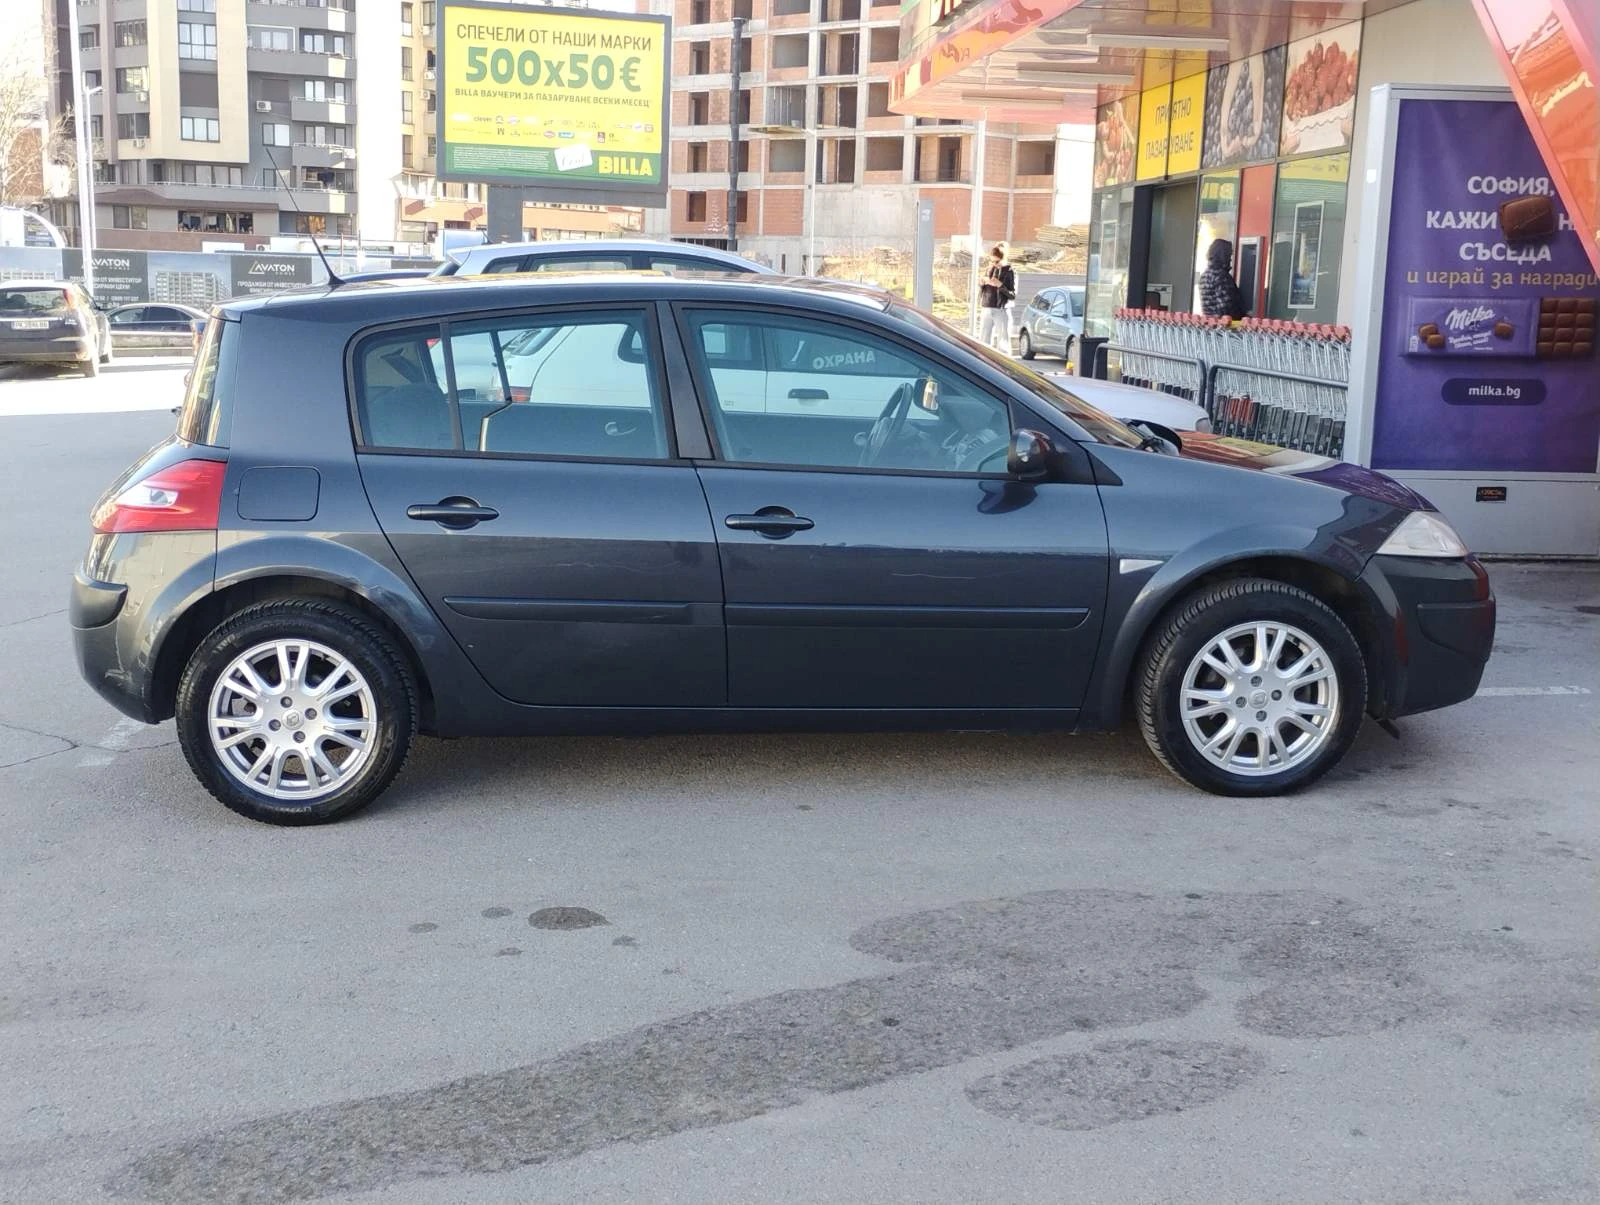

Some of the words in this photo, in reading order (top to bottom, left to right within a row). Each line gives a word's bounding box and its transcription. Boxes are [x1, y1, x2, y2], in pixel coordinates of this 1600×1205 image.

[457, 24, 524, 43] СПЕЧЕЛИ
[529, 29, 548, 44] ОТ
[552, 31, 596, 47] НАШИ
[600, 35, 651, 52] МАРКИ
[455, 88, 478, 97] BILLA
[481, 90, 522, 100] ВАУЧЕРИ
[523, 92, 534, 100] ЗА
[536, 93, 591, 104] ПАЗАРУВАНЕ
[593, 96, 621, 105] ВСЕКИ
[1155, 98, 1191, 124] ПРИЯТНО
[1146, 132, 1193, 159] ПАЗАРУВАНЕ
[598, 156, 653, 177] BILLA
[1467, 176, 1555, 196] СОФИЯ,
[1426, 211, 1497, 230] КАЖИ
[1558, 213, 1576, 231] Н
[1459, 243, 1552, 265] СЪСЕДА
[255, 263, 295, 272] AVATON
[1407, 270, 1419, 283] и
[1426, 268, 1485, 289] играй
[1491, 272, 1513, 289] за
[1445, 305, 1496, 330] Milka
[812, 350, 876, 370] ОХРАНА
[1469, 386, 1521, 399] milka.bg
